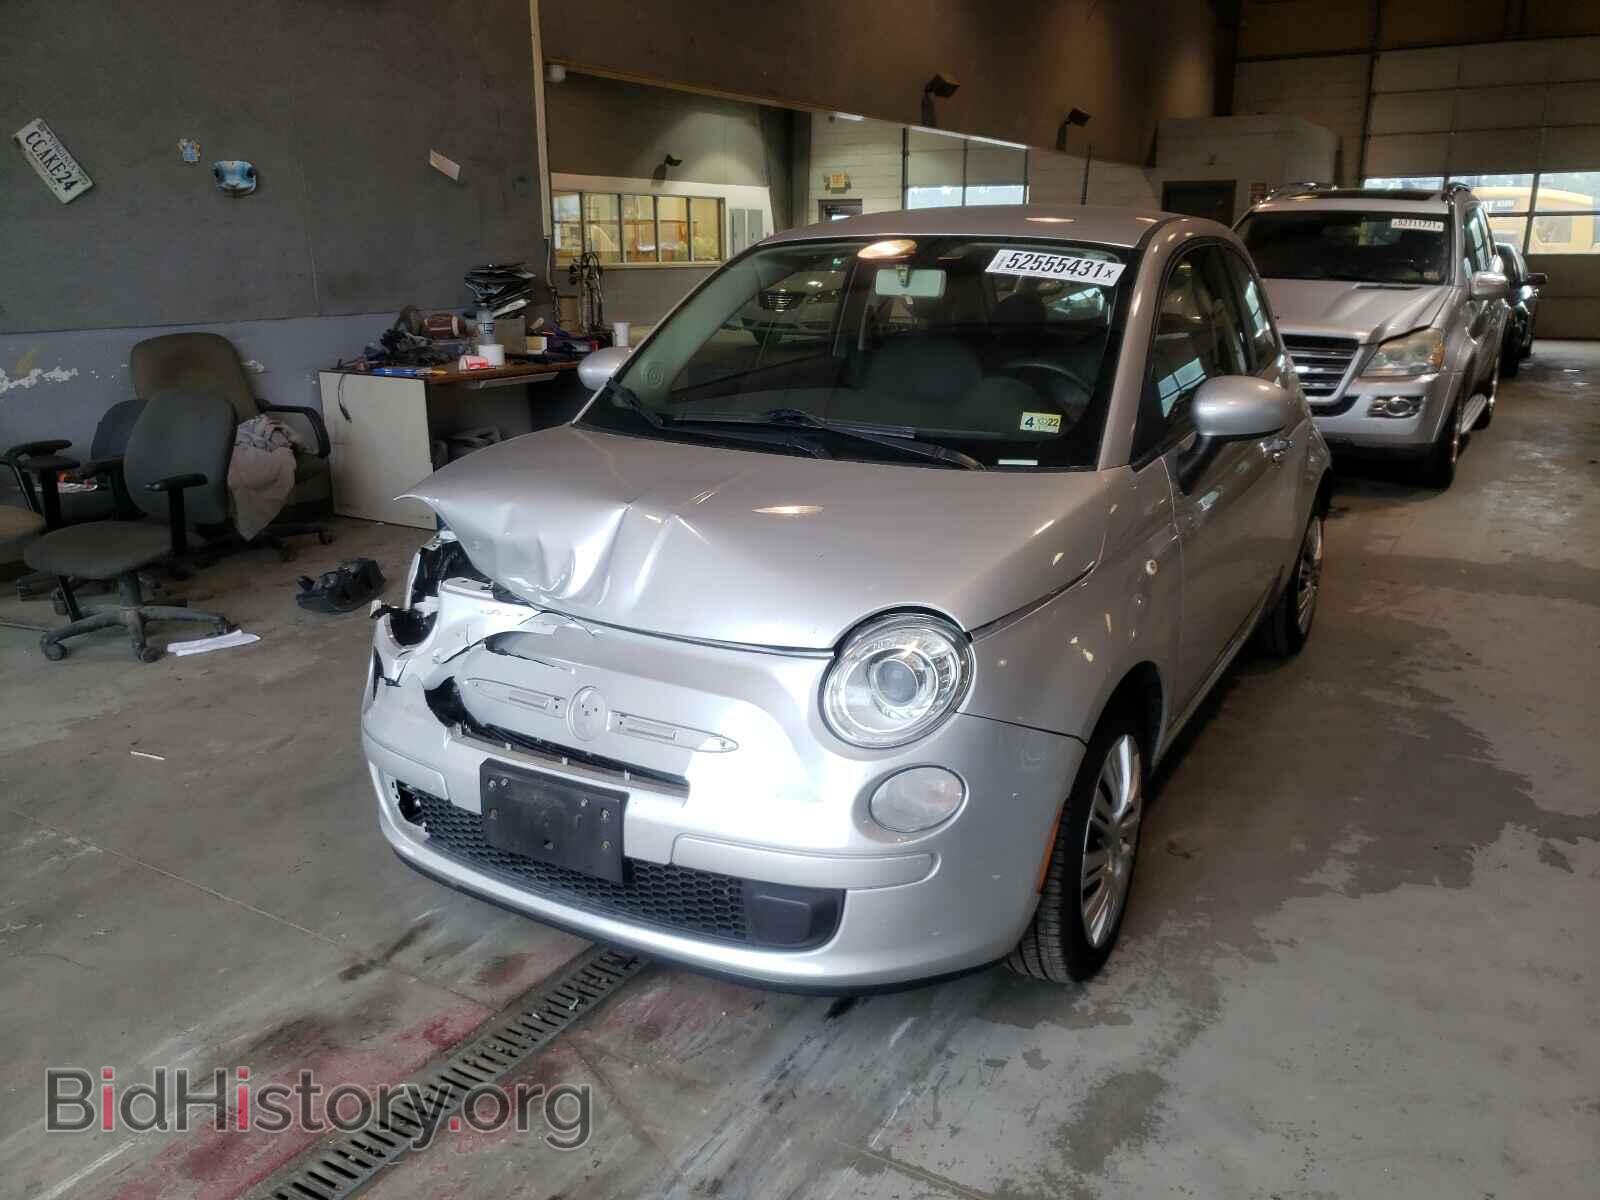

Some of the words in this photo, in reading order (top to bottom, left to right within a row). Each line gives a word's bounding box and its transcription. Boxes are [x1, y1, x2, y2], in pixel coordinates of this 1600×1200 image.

[26, 131, 79, 192] CCAKE24
[1006, 252, 1104, 278] 52555431
[1025, 416, 1034, 427] 4
[1047, 417, 1059, 427] 22
